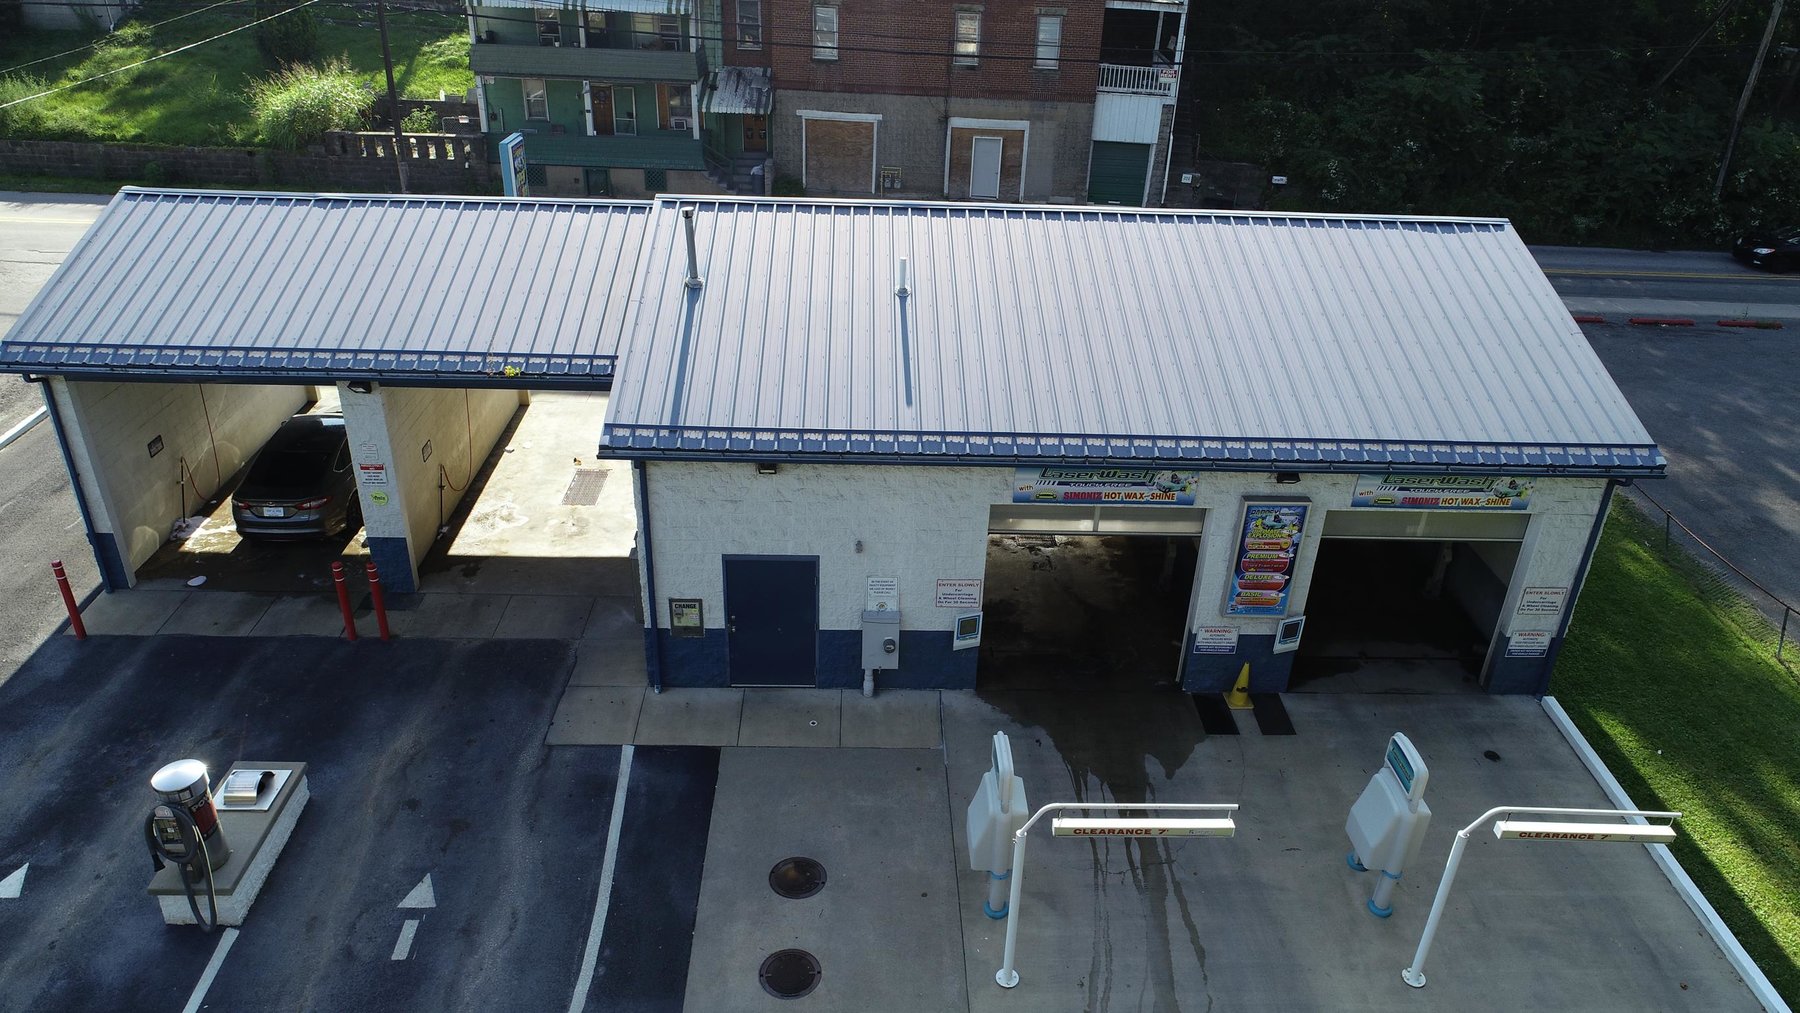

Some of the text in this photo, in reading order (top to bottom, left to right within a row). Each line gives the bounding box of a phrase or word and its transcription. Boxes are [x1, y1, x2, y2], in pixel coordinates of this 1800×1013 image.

[1040, 467, 1158, 486] LaserWash
[1381, 474, 1498, 493] LaserWash
[1064, 492, 1103, 500] SIMONIZ
[1104, 492, 1122, 500] HOT
[1124, 492, 1144, 500] WAX
[1518, 832, 1594, 840] CLEARANCE
